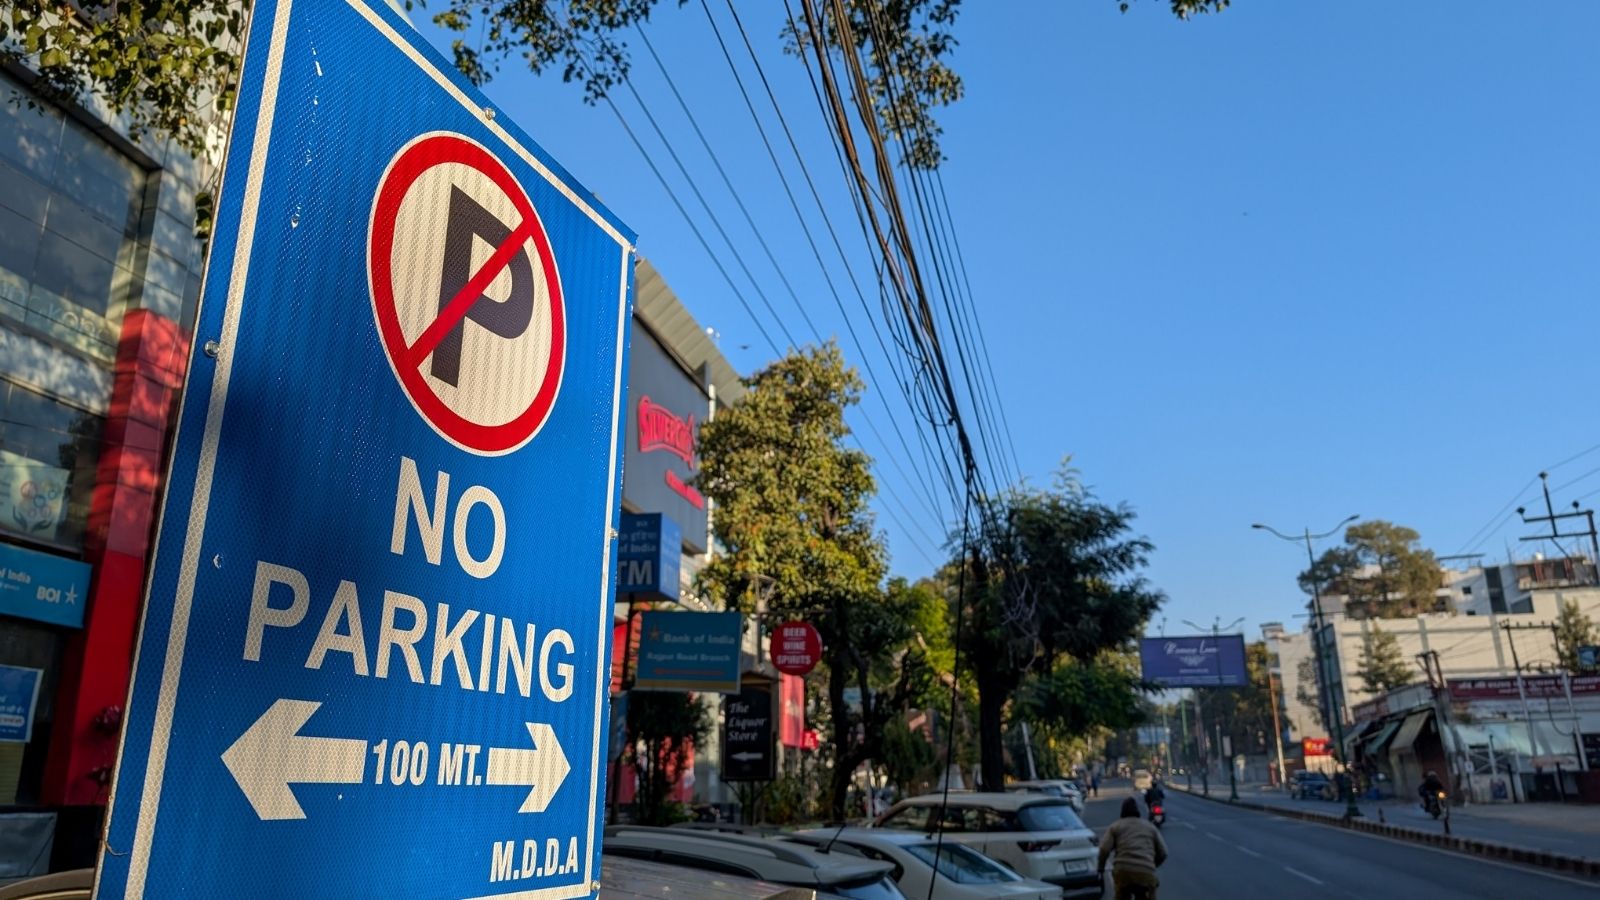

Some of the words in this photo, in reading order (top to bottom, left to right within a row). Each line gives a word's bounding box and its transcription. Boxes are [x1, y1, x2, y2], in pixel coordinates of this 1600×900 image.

[391, 456, 506, 579] NO
[631, 543, 657, 553] India
[8, 569, 31, 584] India
[37, 586, 61, 603] BOI
[243, 560, 575, 702] PARKING
[783, 628, 807, 637] BEER
[663, 632, 691, 643] Bank
[693, 633, 706, 644] of
[708, 633, 736, 645] India
[783, 641, 806, 650] WINE
[676, 652, 699, 661] Road
[700, 653, 731, 662] Branch
[776, 655, 812, 665] SPIRITS
[729, 702, 750, 714] The
[728, 717, 767, 731] Liquor
[728, 731, 759, 742] Store
[373, 739, 428, 786] 100
[438, 744, 482, 786] MT.
[489, 836, 579, 882] M.D.D.A
